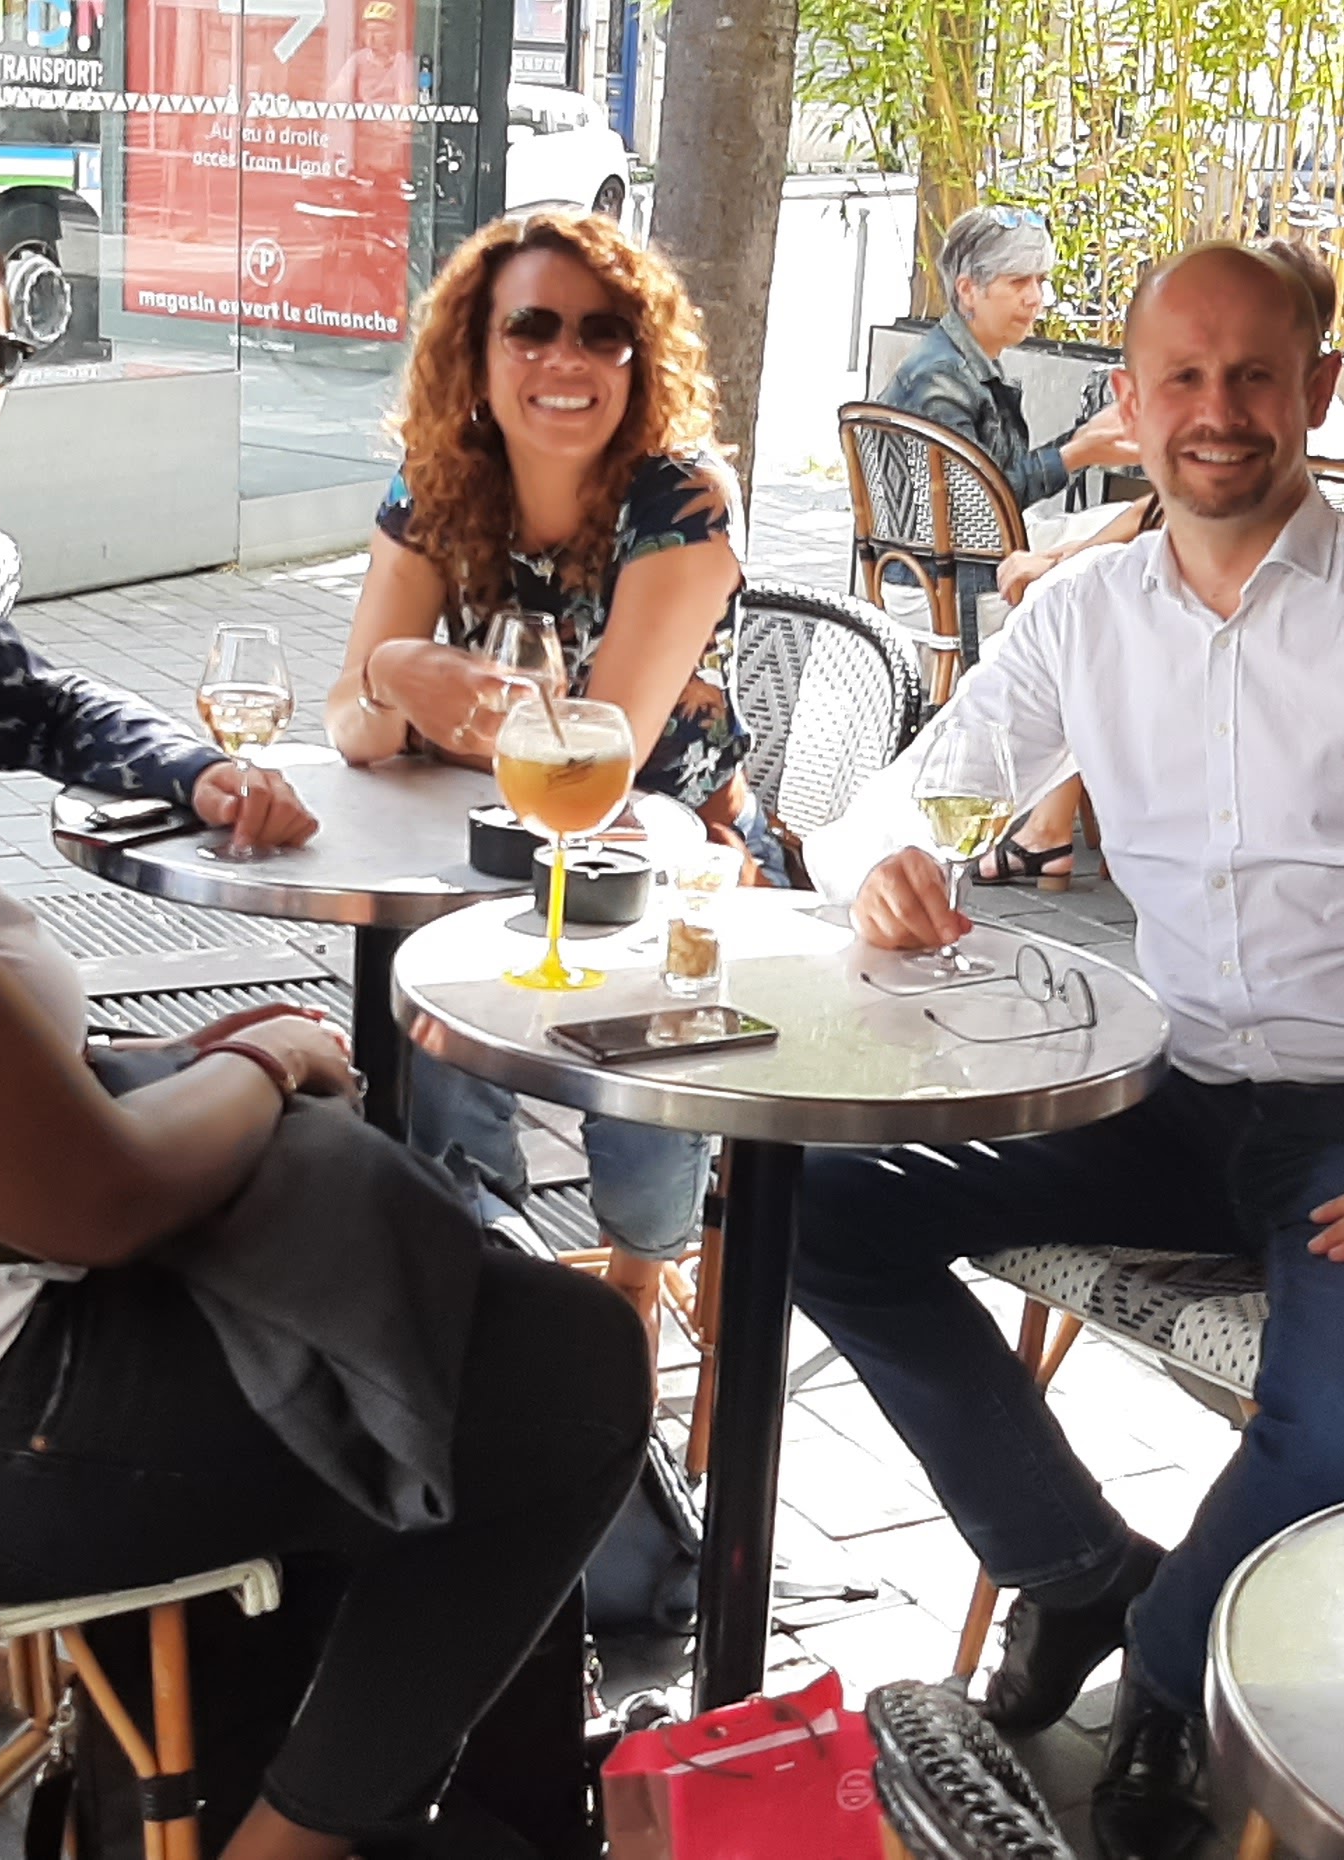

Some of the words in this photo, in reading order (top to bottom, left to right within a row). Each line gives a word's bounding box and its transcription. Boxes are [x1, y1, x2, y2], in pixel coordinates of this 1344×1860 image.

[265, 123, 276, 145] à
[280, 126, 330, 148] droite
[192, 149, 237, 168] accès
[286, 155, 331, 179] Ligne
[139, 290, 216, 314] magasin
[219, 299, 280, 320] ouvert
[283, 300, 301, 323] le
[305, 303, 398, 333] dimanche
